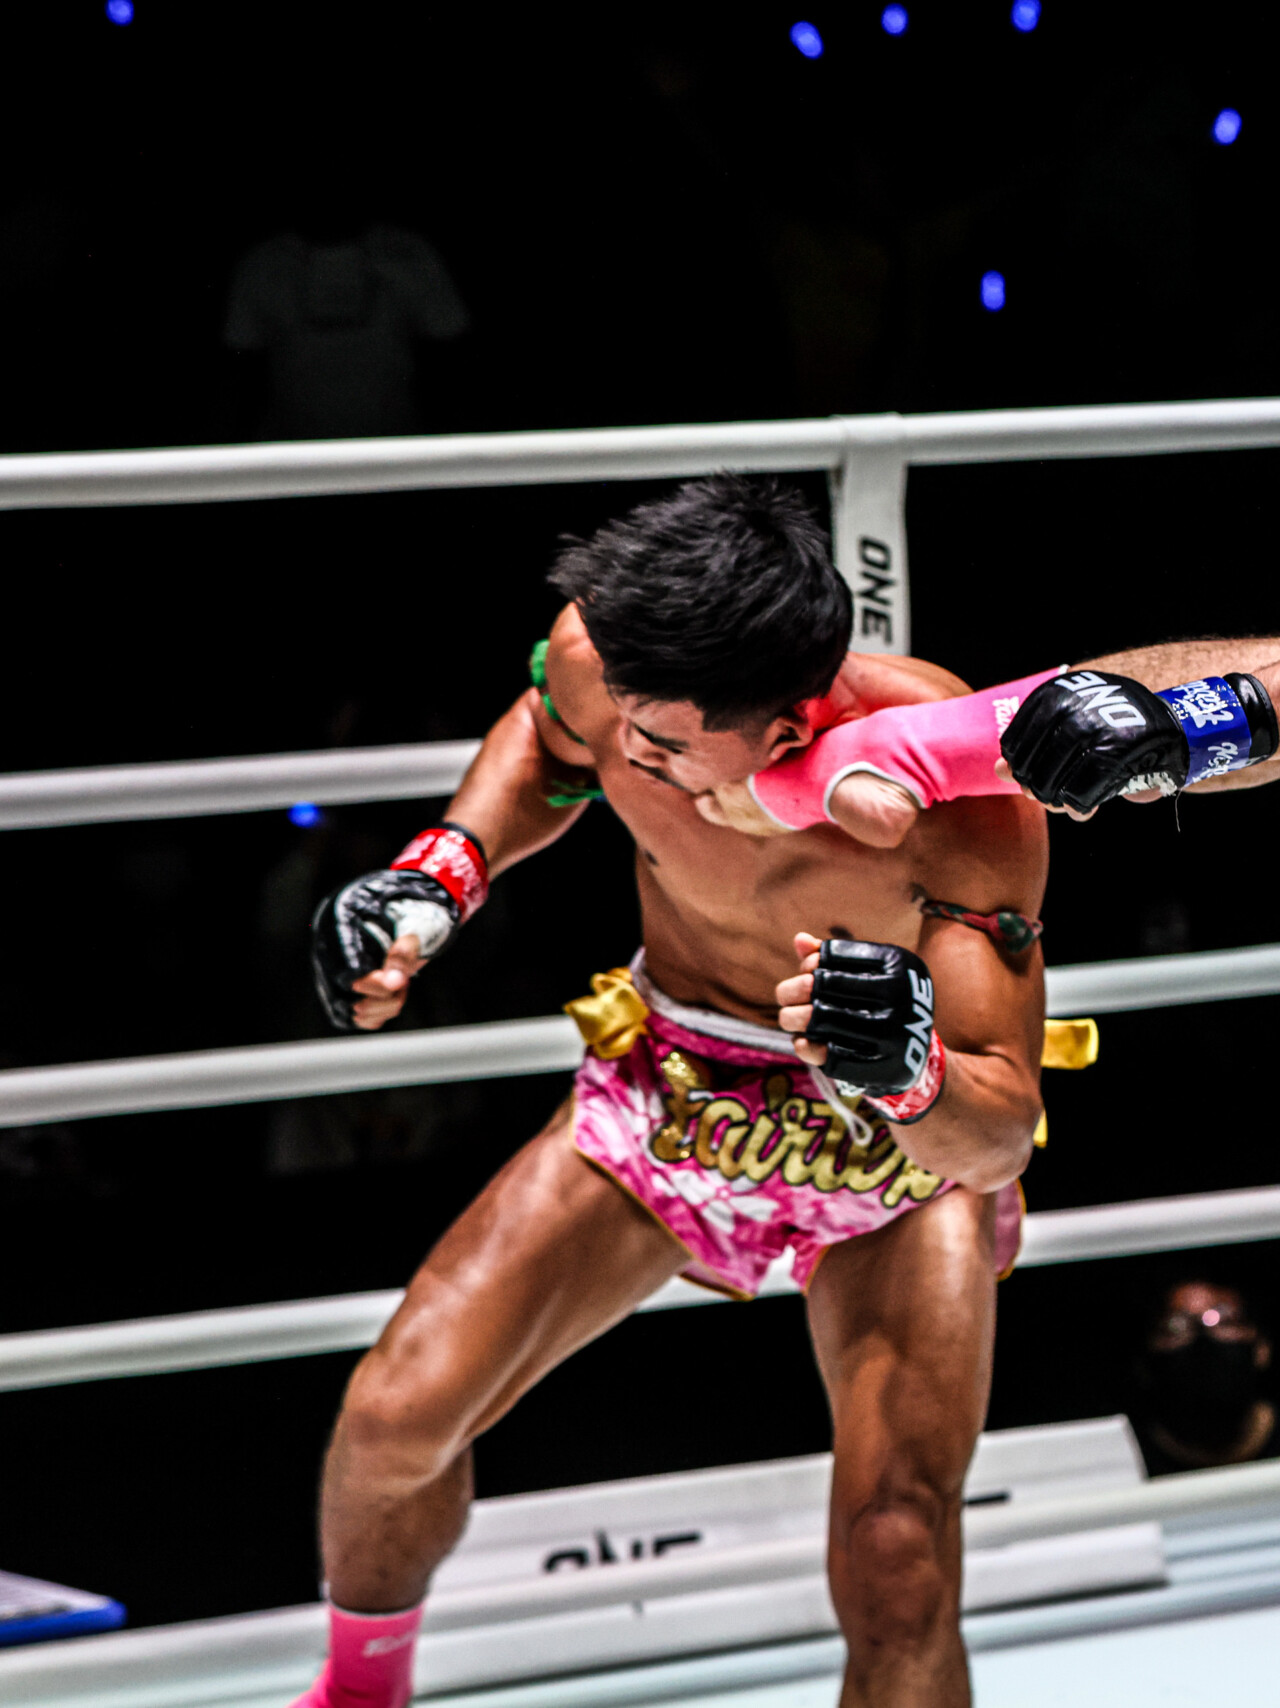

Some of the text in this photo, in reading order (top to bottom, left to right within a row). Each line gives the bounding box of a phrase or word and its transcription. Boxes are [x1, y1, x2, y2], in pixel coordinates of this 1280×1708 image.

[857, 536, 897, 645] ONE
[1054, 670, 1147, 728] ONE
[904, 968, 935, 1079] ONE
